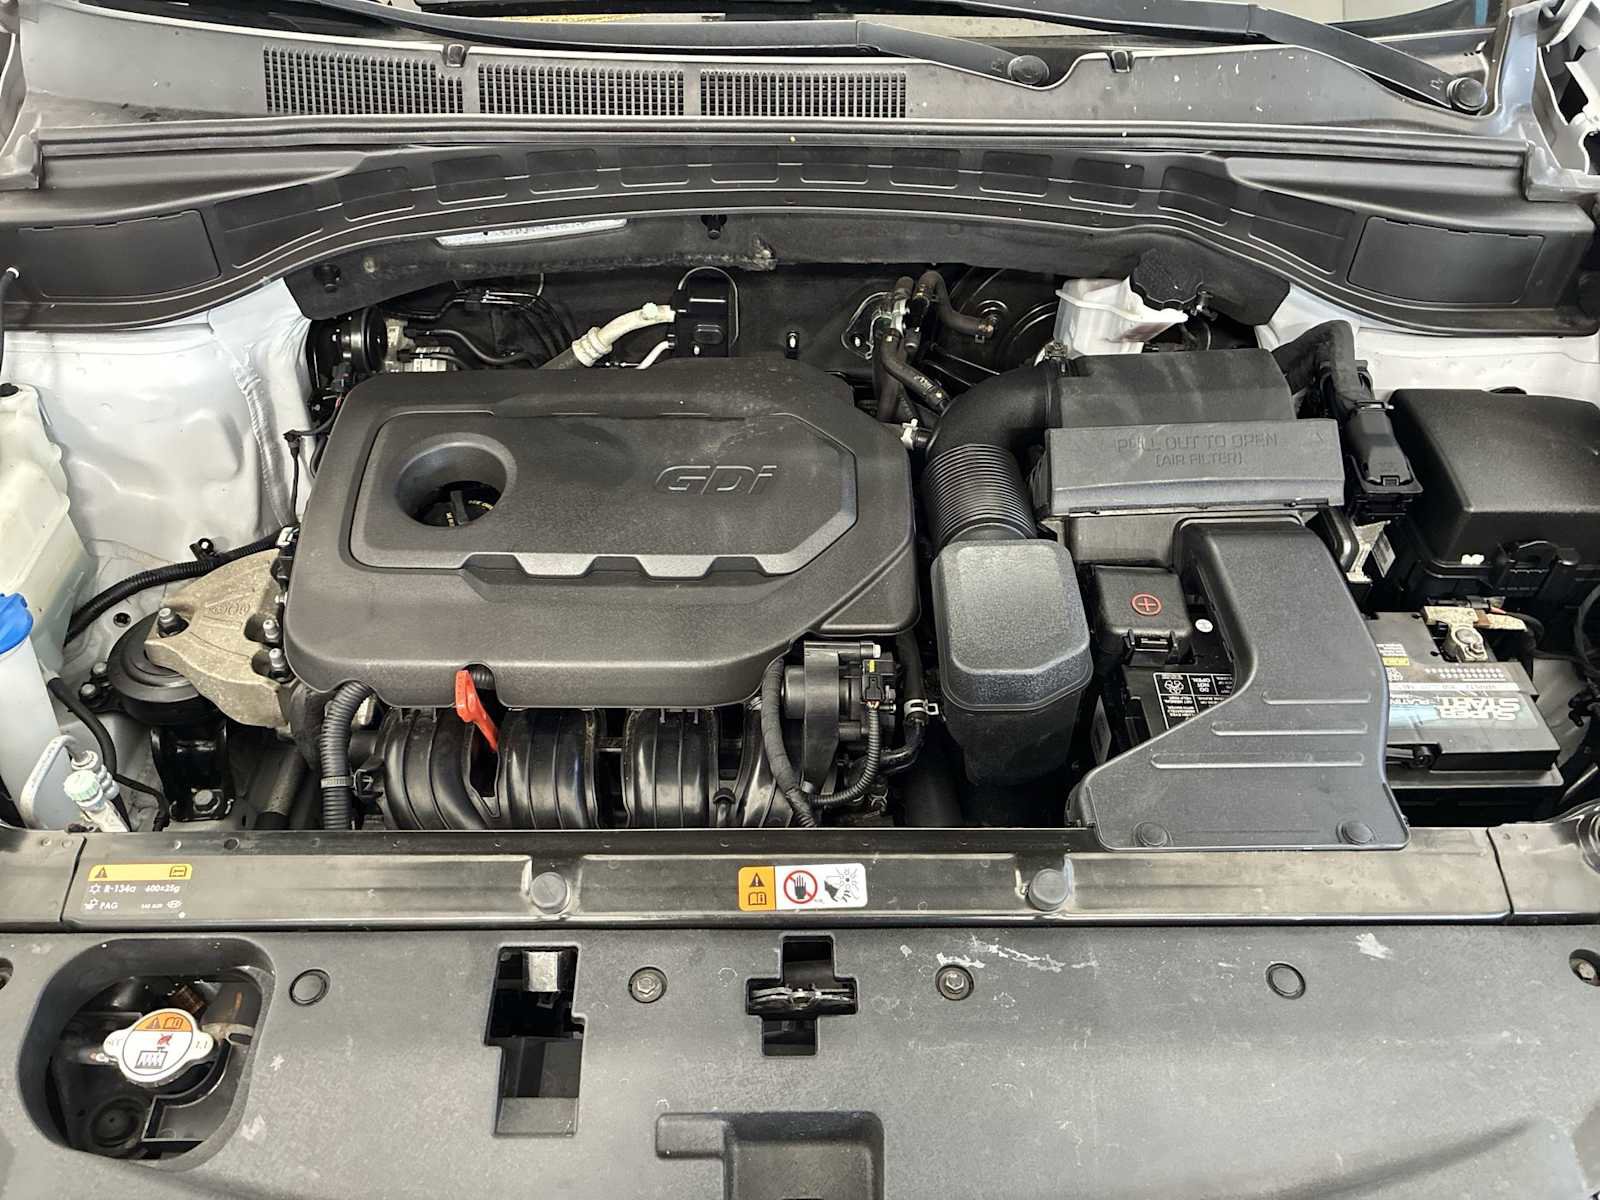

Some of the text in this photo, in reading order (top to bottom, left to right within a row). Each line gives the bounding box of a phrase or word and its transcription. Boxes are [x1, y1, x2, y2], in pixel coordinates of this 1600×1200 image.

[1116, 432, 1278, 452] PULL OUT TO OPEN
[1389, 697, 1430, 705] PLATIN
[1437, 697, 1521, 713] START
[1439, 708, 1517, 721] SUPER
[100, 902, 119, 910] PAG
